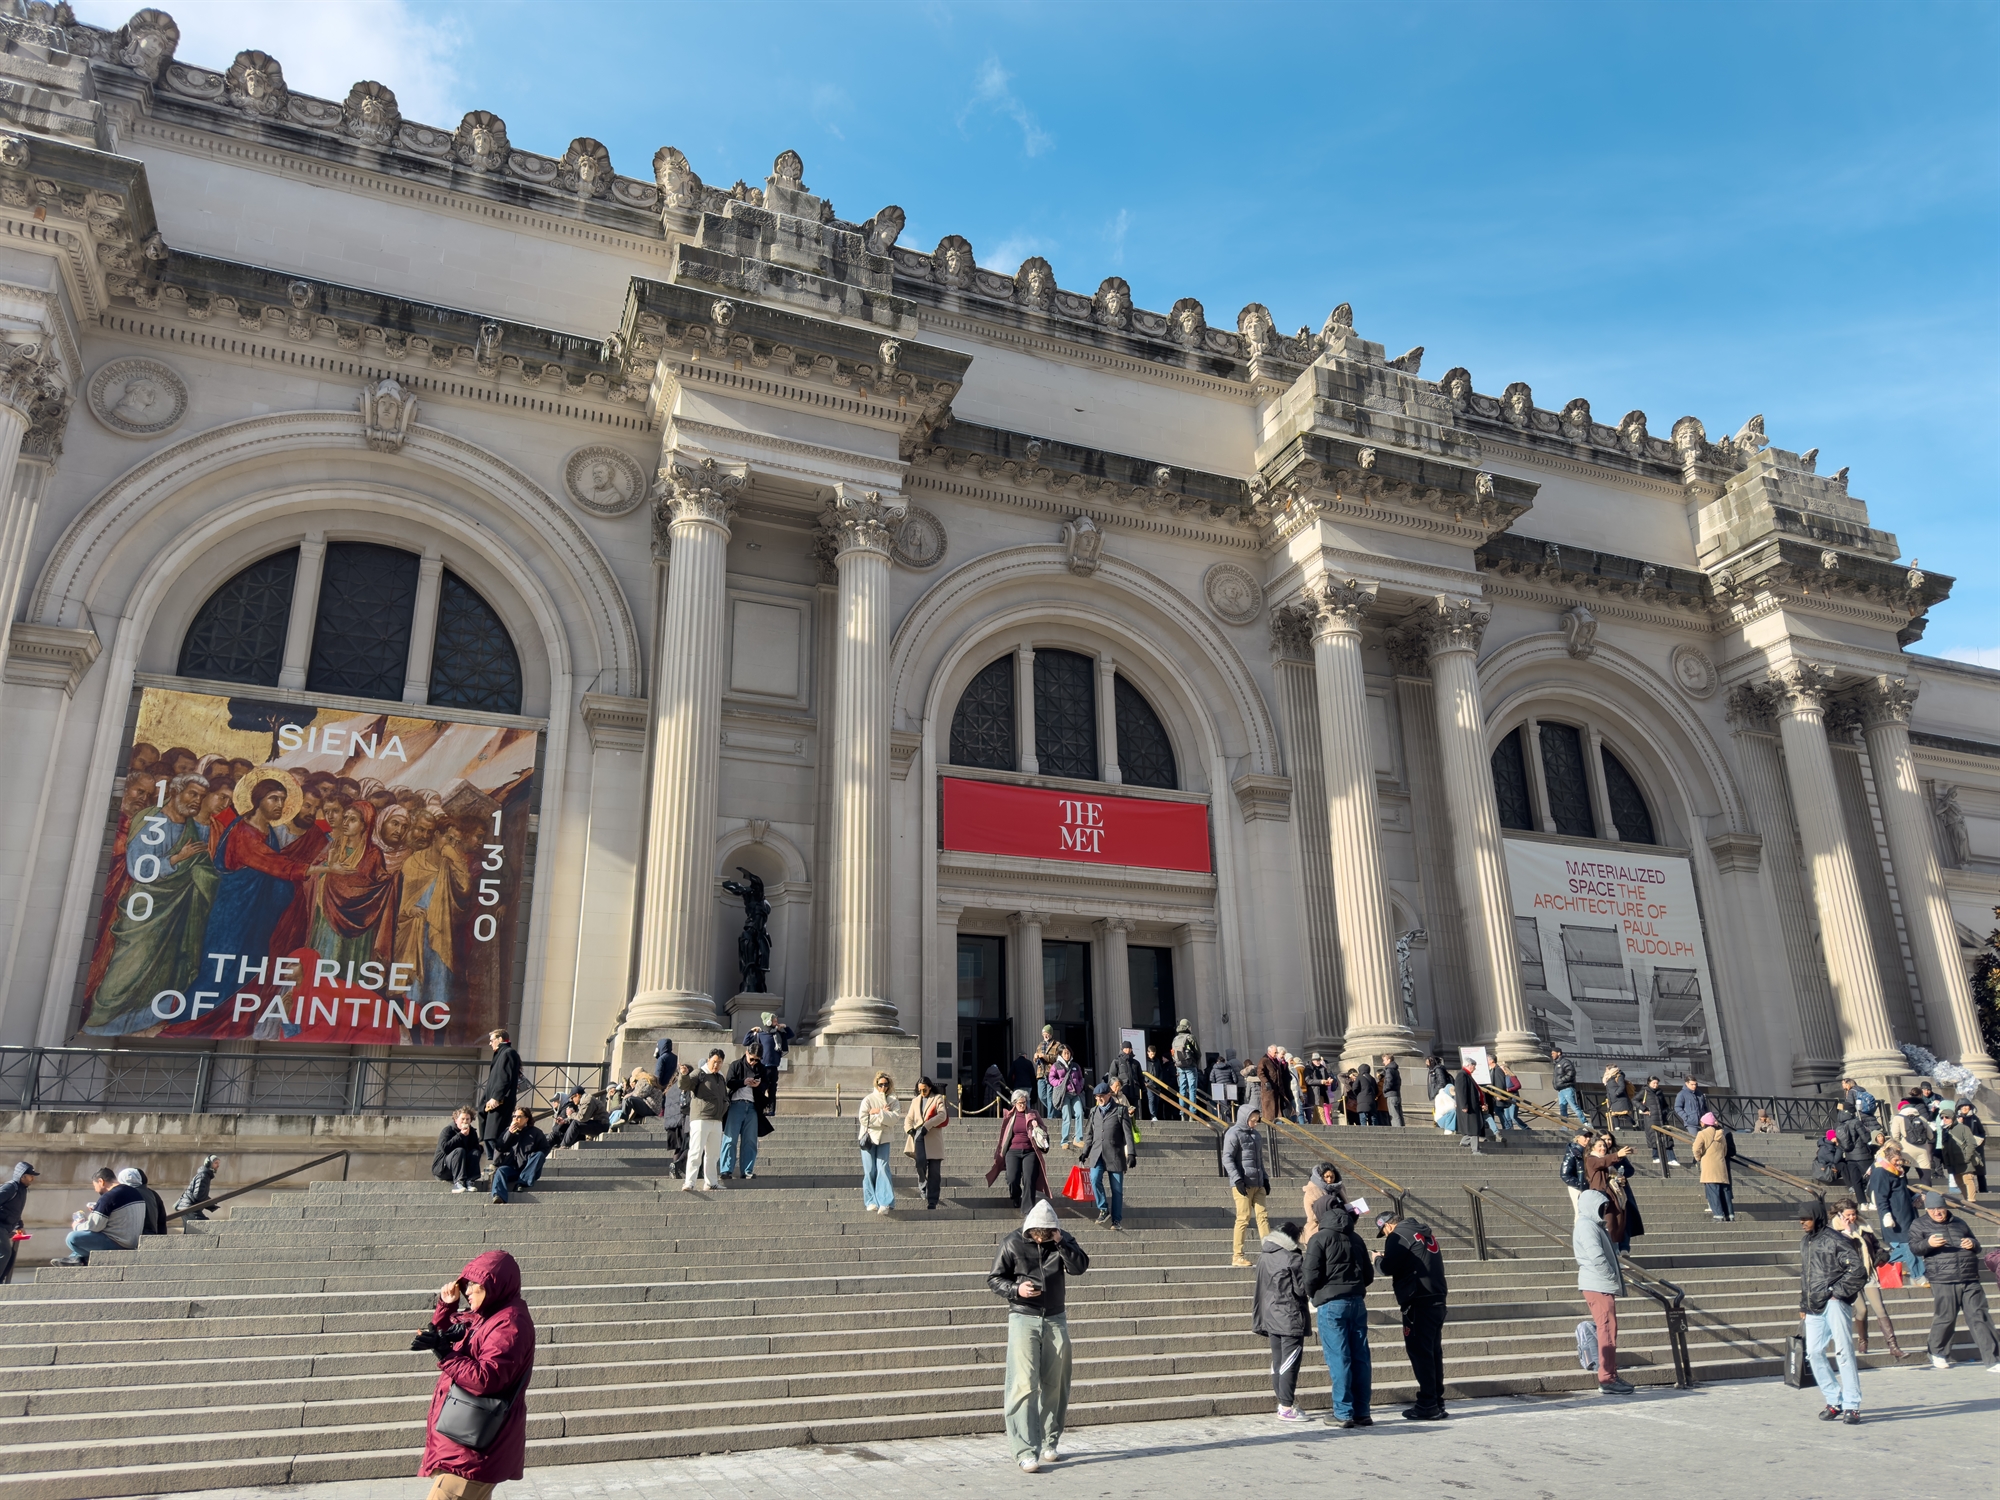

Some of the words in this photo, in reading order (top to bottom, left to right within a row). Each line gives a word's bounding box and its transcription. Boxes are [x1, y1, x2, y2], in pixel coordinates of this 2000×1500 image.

[277, 723, 407, 762] SIENA
[1059, 800, 1103, 827] THE
[127, 779, 166, 921] 1300
[1058, 825, 1105, 853] MET
[473, 810, 504, 941] 1350
[1566, 860, 1665, 884] MATERIALIZED
[1569, 879, 1615, 897] SPACE
[1617, 884, 1646, 900] THE
[1533, 893, 1644, 918] ARCHITECTURE
[1648, 904, 1667, 919] OF
[1623, 920, 1658, 937] PAUL
[1626, 938, 1694, 957] RUDOLPH
[207, 953, 300, 987] THE
[313, 959, 414, 992] RISE
[150, 989, 218, 1020] OF
[232, 994, 451, 1030] PAINTING
